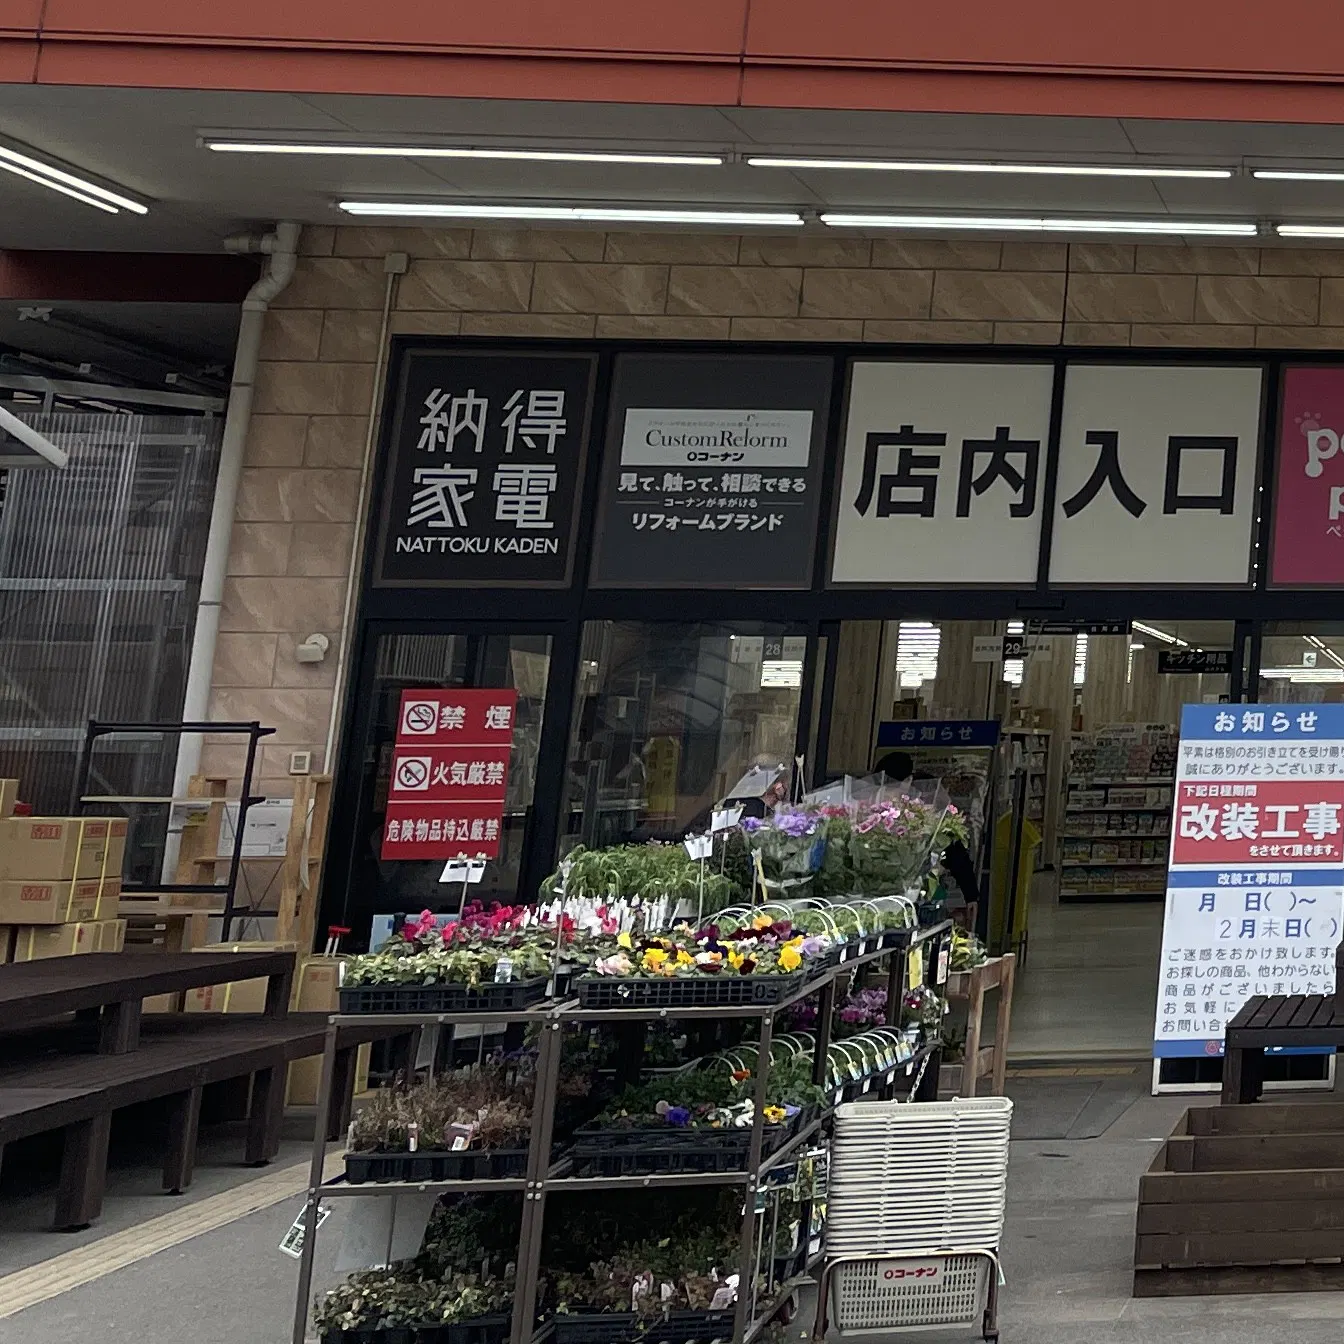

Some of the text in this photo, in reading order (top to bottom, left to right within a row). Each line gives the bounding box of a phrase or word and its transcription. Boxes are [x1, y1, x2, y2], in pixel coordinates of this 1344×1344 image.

[416, 386, 568, 456] 納得
[696, 451, 745, 462] コーナン
[406, 462, 559, 530] 家電
[663, 497, 759, 509] コーナンが手がける
[631, 512, 785, 532] リフォームブランド
[395, 535, 559, 555] NATTOKU KADEN
[765, 643, 781, 657] 28
[1005, 642, 1021, 655] 29
[1213, 710, 1319, 733] お知らせ
[900, 725, 974, 742] お知らせ
[432, 760, 505, 788] 火気厳禁
[1178, 801, 1343, 842] 改装工事
[385, 818, 500, 843] 危険物品持込厳禁
[1249, 843, 1340, 858] をさせて頂きます。
[1217, 872, 1294, 886] 改装工事期間
[1167, 946, 1336, 963] ご迷惑をおかけ致します。
[894, 1267, 938, 1279] コーナン
